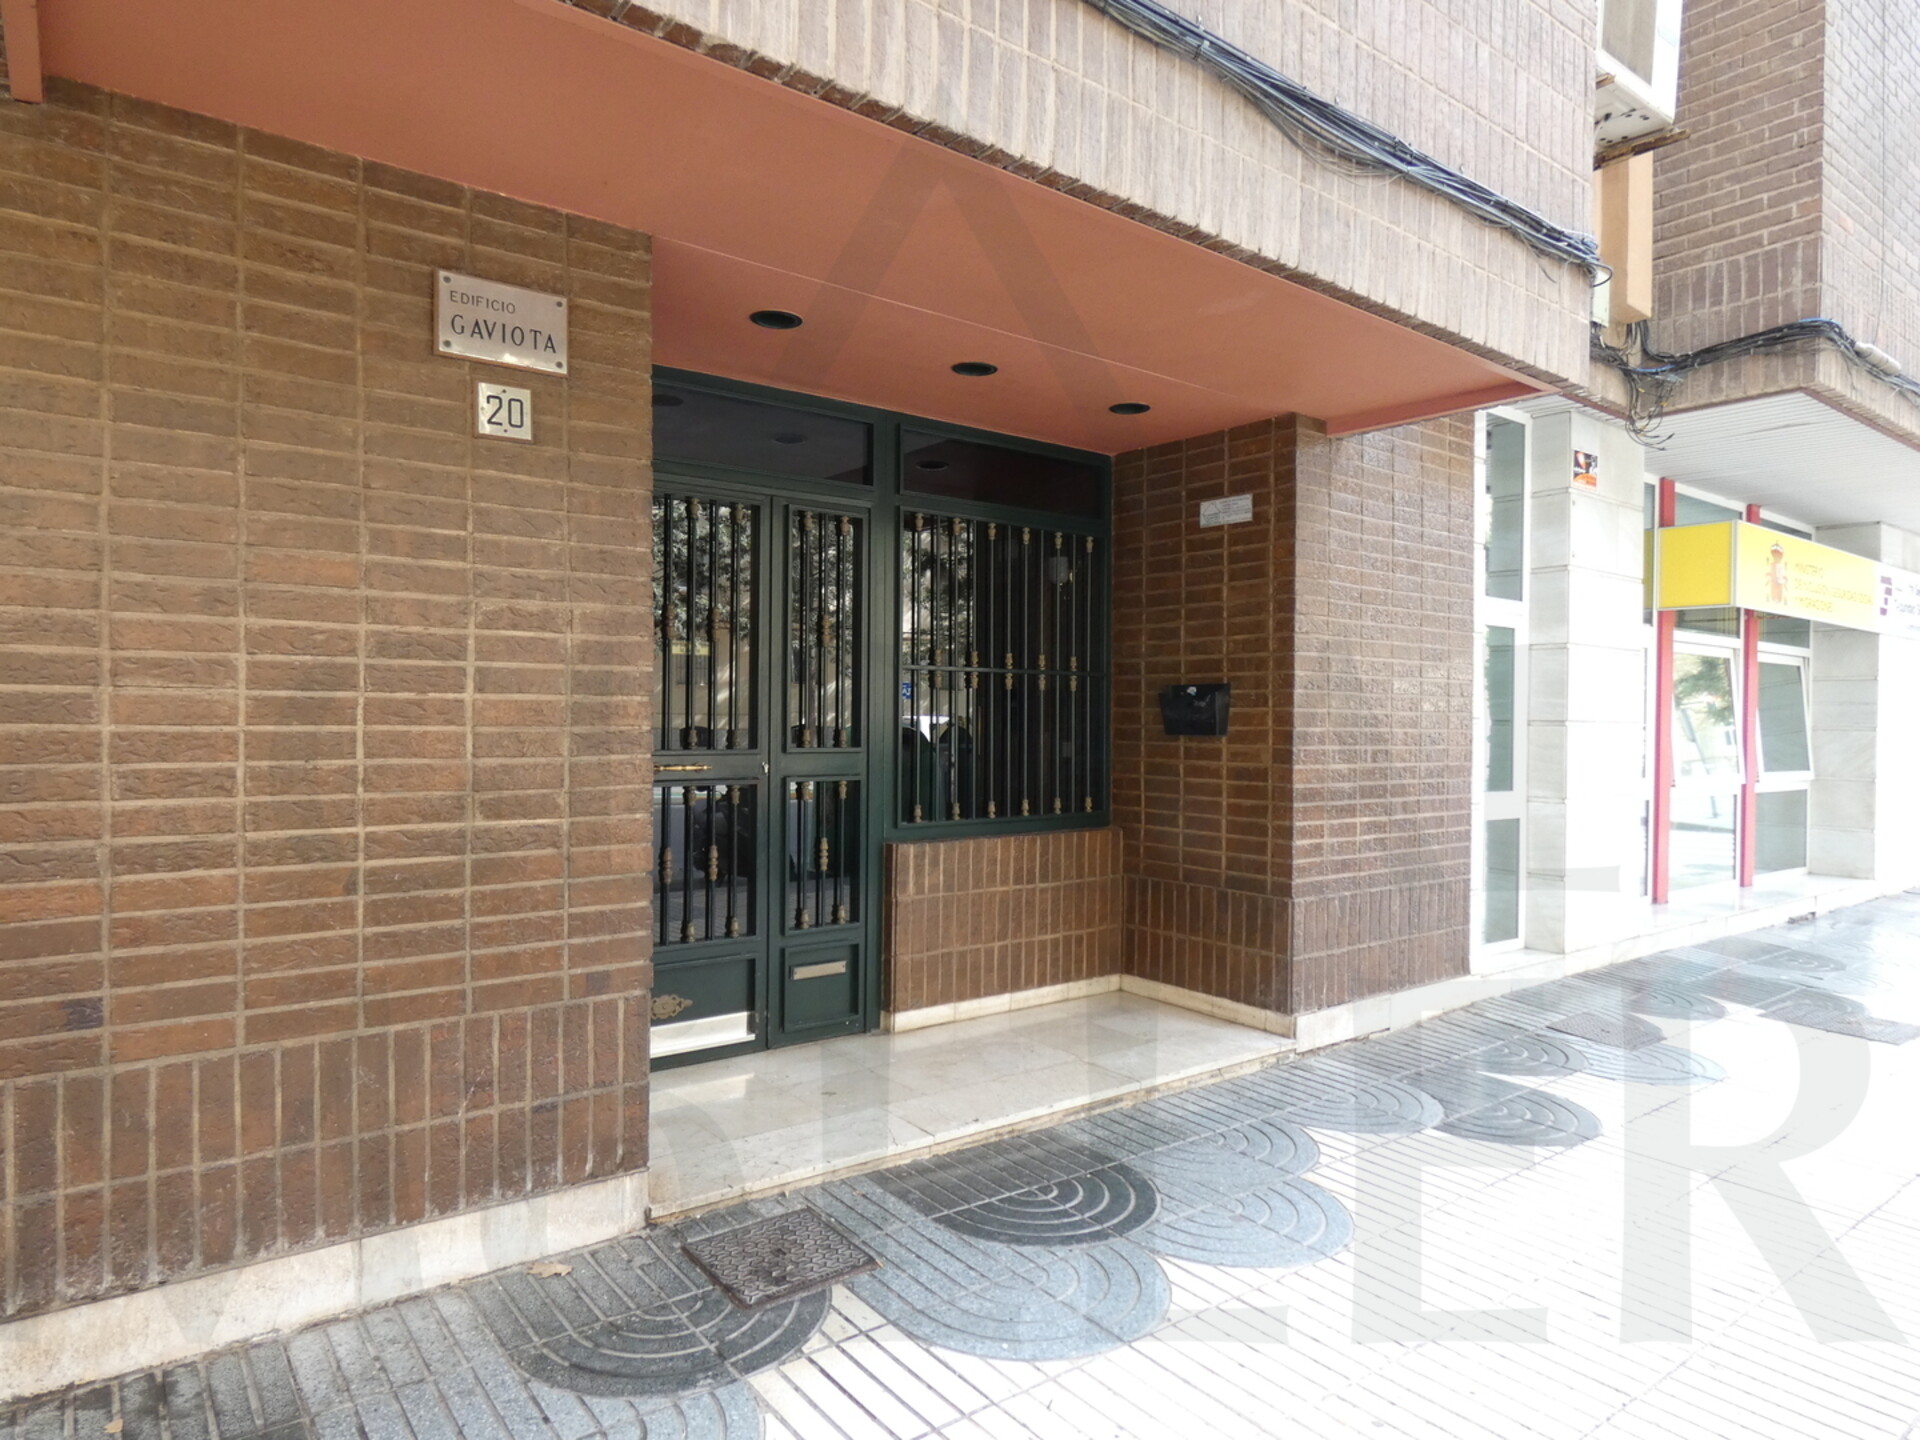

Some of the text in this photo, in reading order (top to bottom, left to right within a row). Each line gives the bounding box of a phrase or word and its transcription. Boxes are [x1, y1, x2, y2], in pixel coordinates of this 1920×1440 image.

[449, 290, 517, 315] EDIFICIO
[451, 314, 557, 354] GAVIOTA
[486, 394, 524, 429] 20
